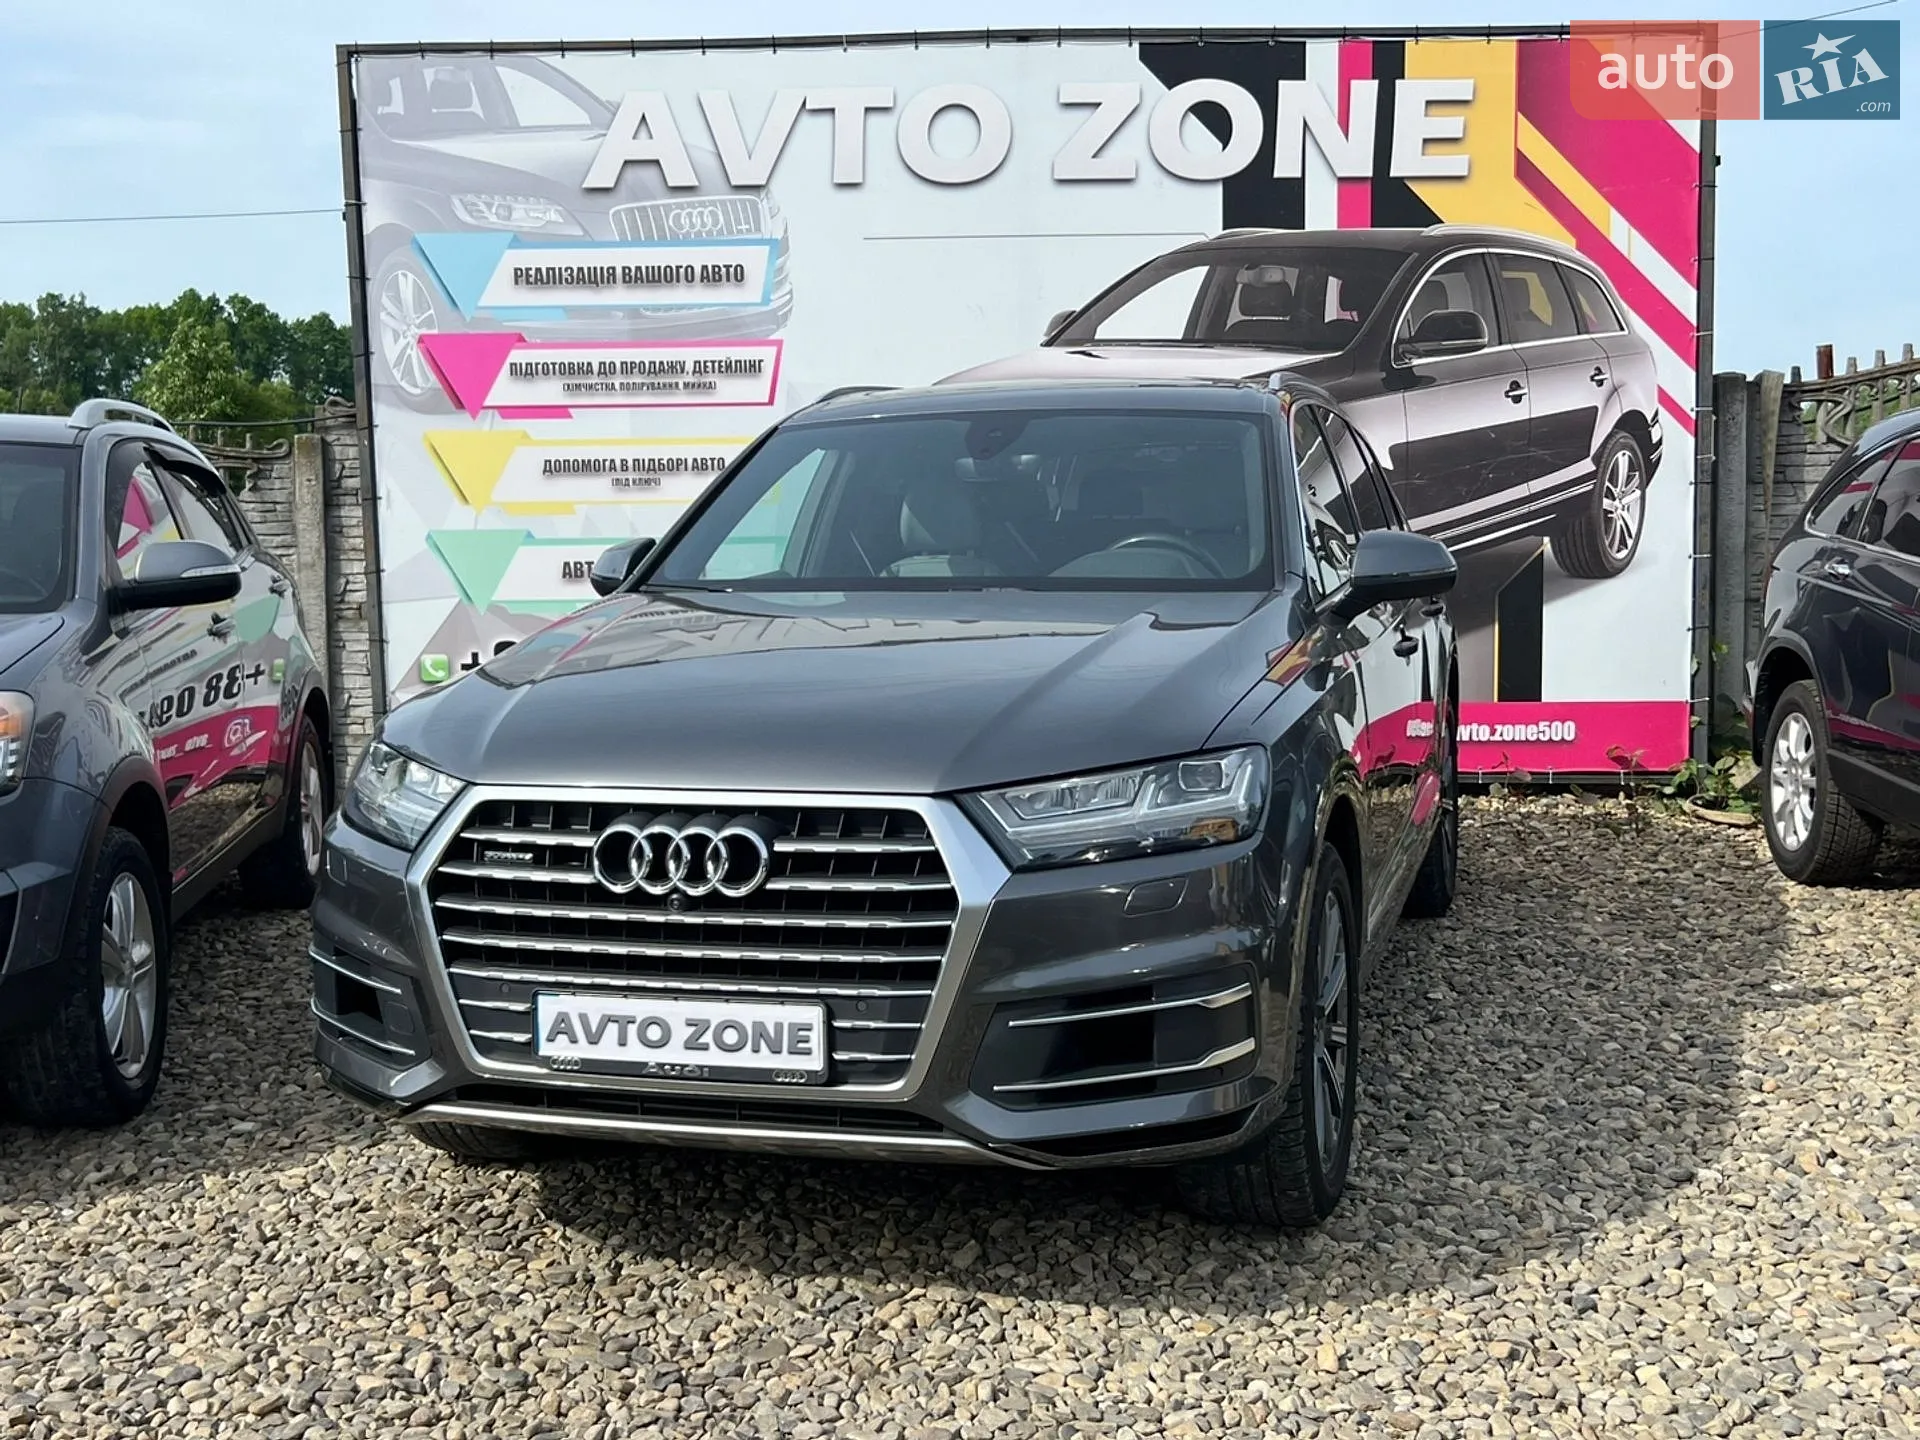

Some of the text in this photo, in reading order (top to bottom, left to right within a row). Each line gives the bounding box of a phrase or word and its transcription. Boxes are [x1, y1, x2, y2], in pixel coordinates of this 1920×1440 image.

[581, 78, 1476, 190] AVTO ZONE
[513, 264, 745, 287] РЕАЛІЗАЦІЯ ВАШОГО АВТО
[509, 361, 594, 378] ПІДГОТОВКА
[597, 361, 617, 378] ДО
[692, 357, 765, 377] ДЕТЕЙЛІНГ
[542, 457, 726, 475] ДОПОМОГА В ПІДБОРІ АВТО
[546, 1011, 813, 1055] AVTO ZONE
